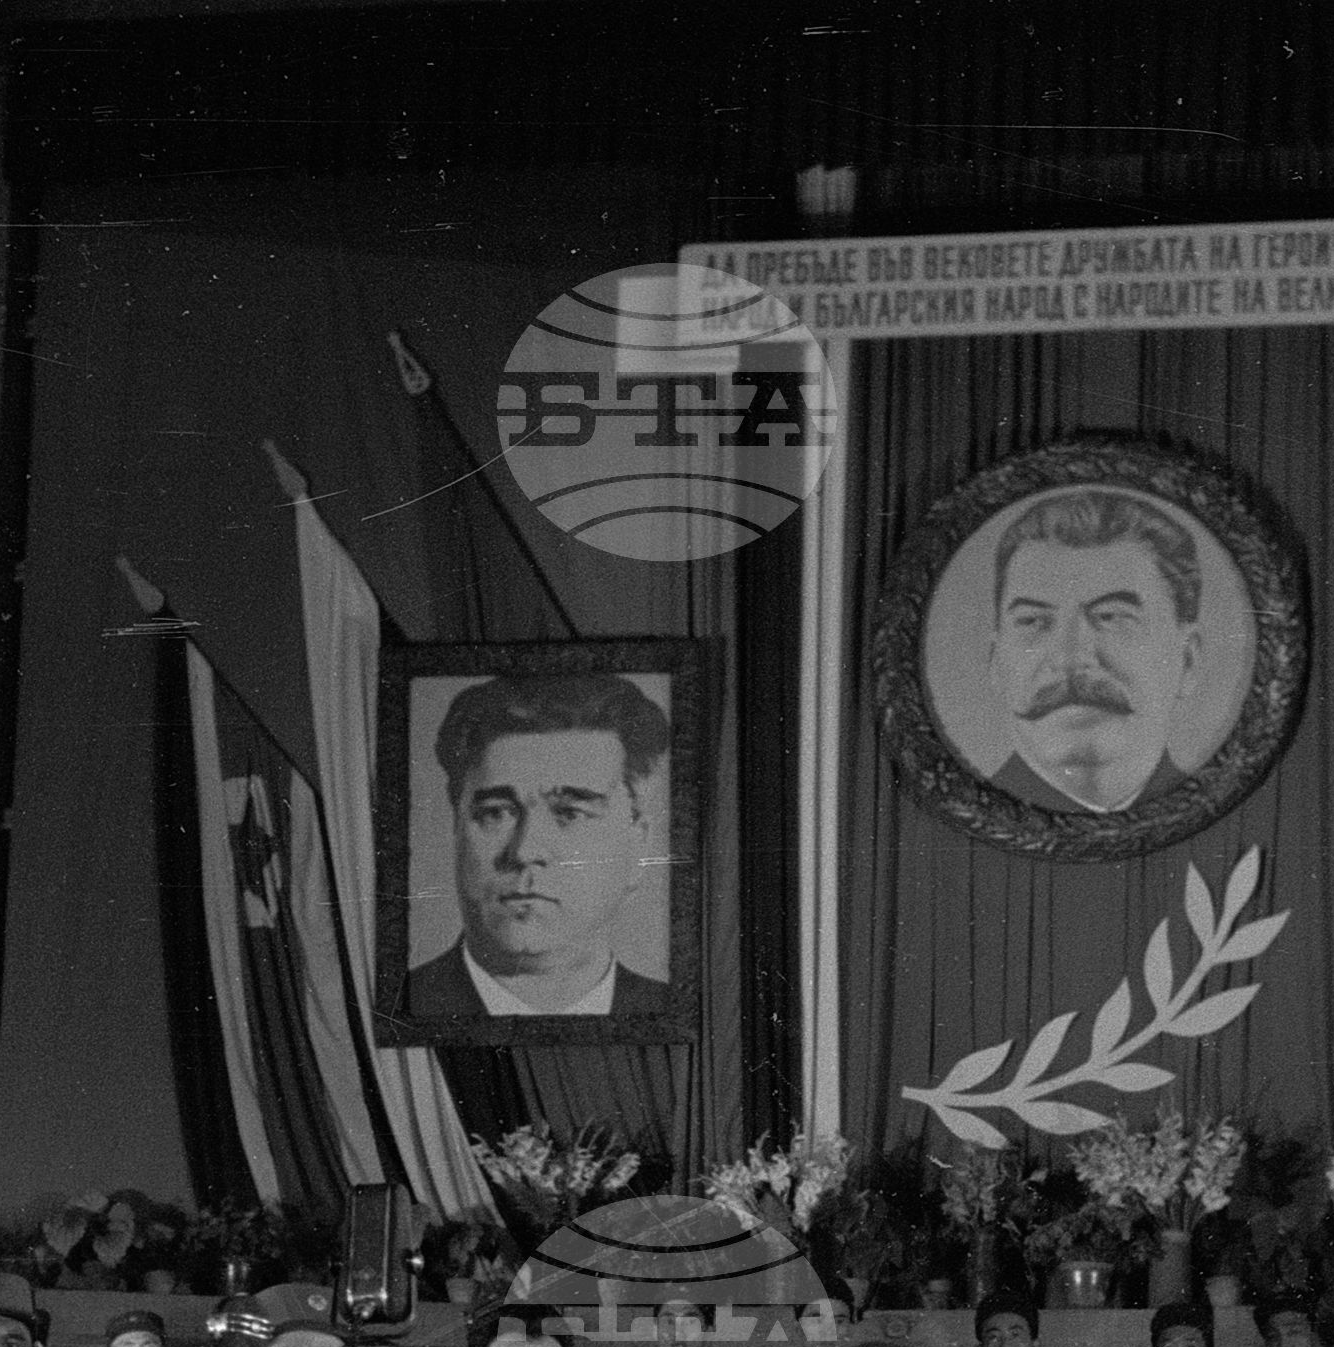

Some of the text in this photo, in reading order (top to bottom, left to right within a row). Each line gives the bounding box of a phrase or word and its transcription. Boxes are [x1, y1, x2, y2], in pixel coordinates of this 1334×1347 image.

[701, 252, 740, 290] ДА
[746, 248, 858, 287] ПРЕБЪДЕ
[867, 246, 914, 282] ВЪВ
[924, 241, 1052, 280] ВЕКОВЕТЕ
[1059, 235, 1197, 278] ДРУЖБАТА
[1209, 234, 1244, 271] НА
[814, 289, 976, 328] БЪЛГАРСКИЯ
[986, 283, 1065, 320] НАРОД
[1073, 283, 1089, 318] С
[1096, 279, 1223, 316] НАРОДИТЕ
[1234, 278, 1267, 313] НА
